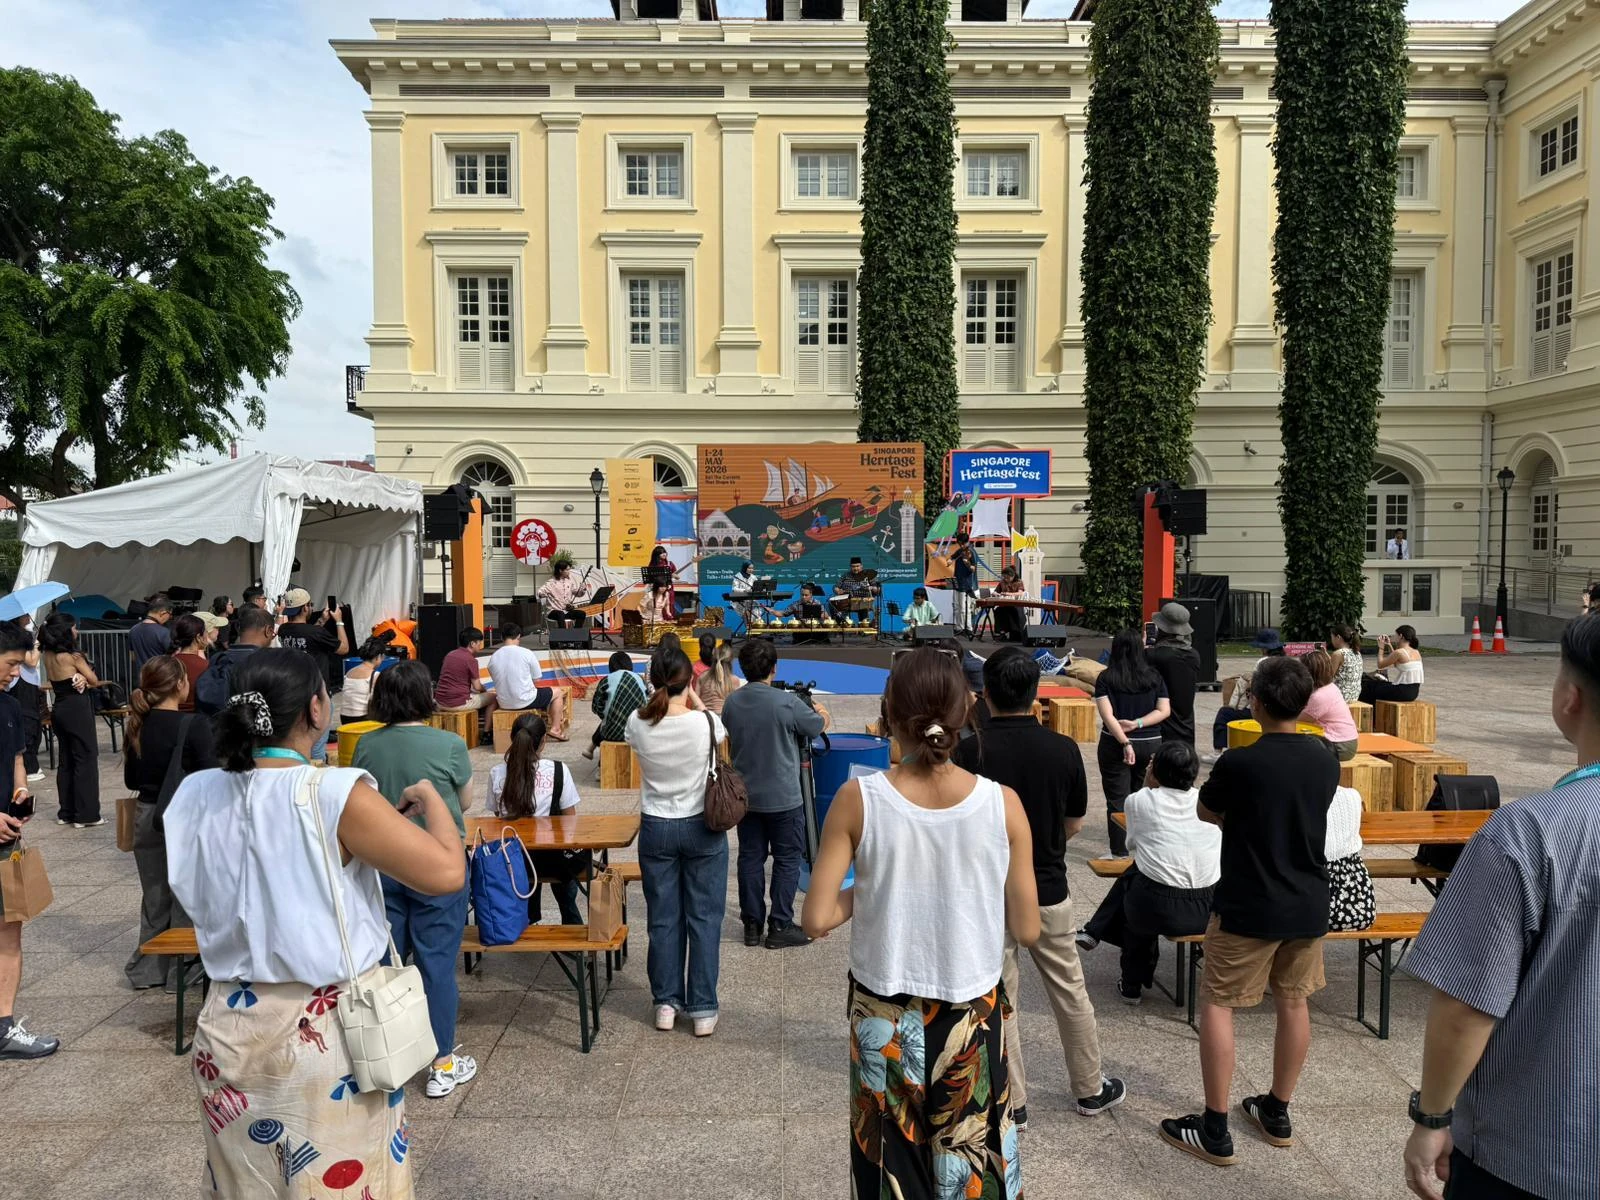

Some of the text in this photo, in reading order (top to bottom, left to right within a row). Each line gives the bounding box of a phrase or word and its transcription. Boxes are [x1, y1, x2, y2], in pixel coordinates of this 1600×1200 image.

[705, 457, 723, 465] MAY
[860, 453, 916, 467] Heritage
[970, 457, 1031, 468] SINGAPORE
[705, 465, 727, 473] 2026
[890, 466, 917, 479] Fest
[960, 466, 1041, 481] HeritageFest
